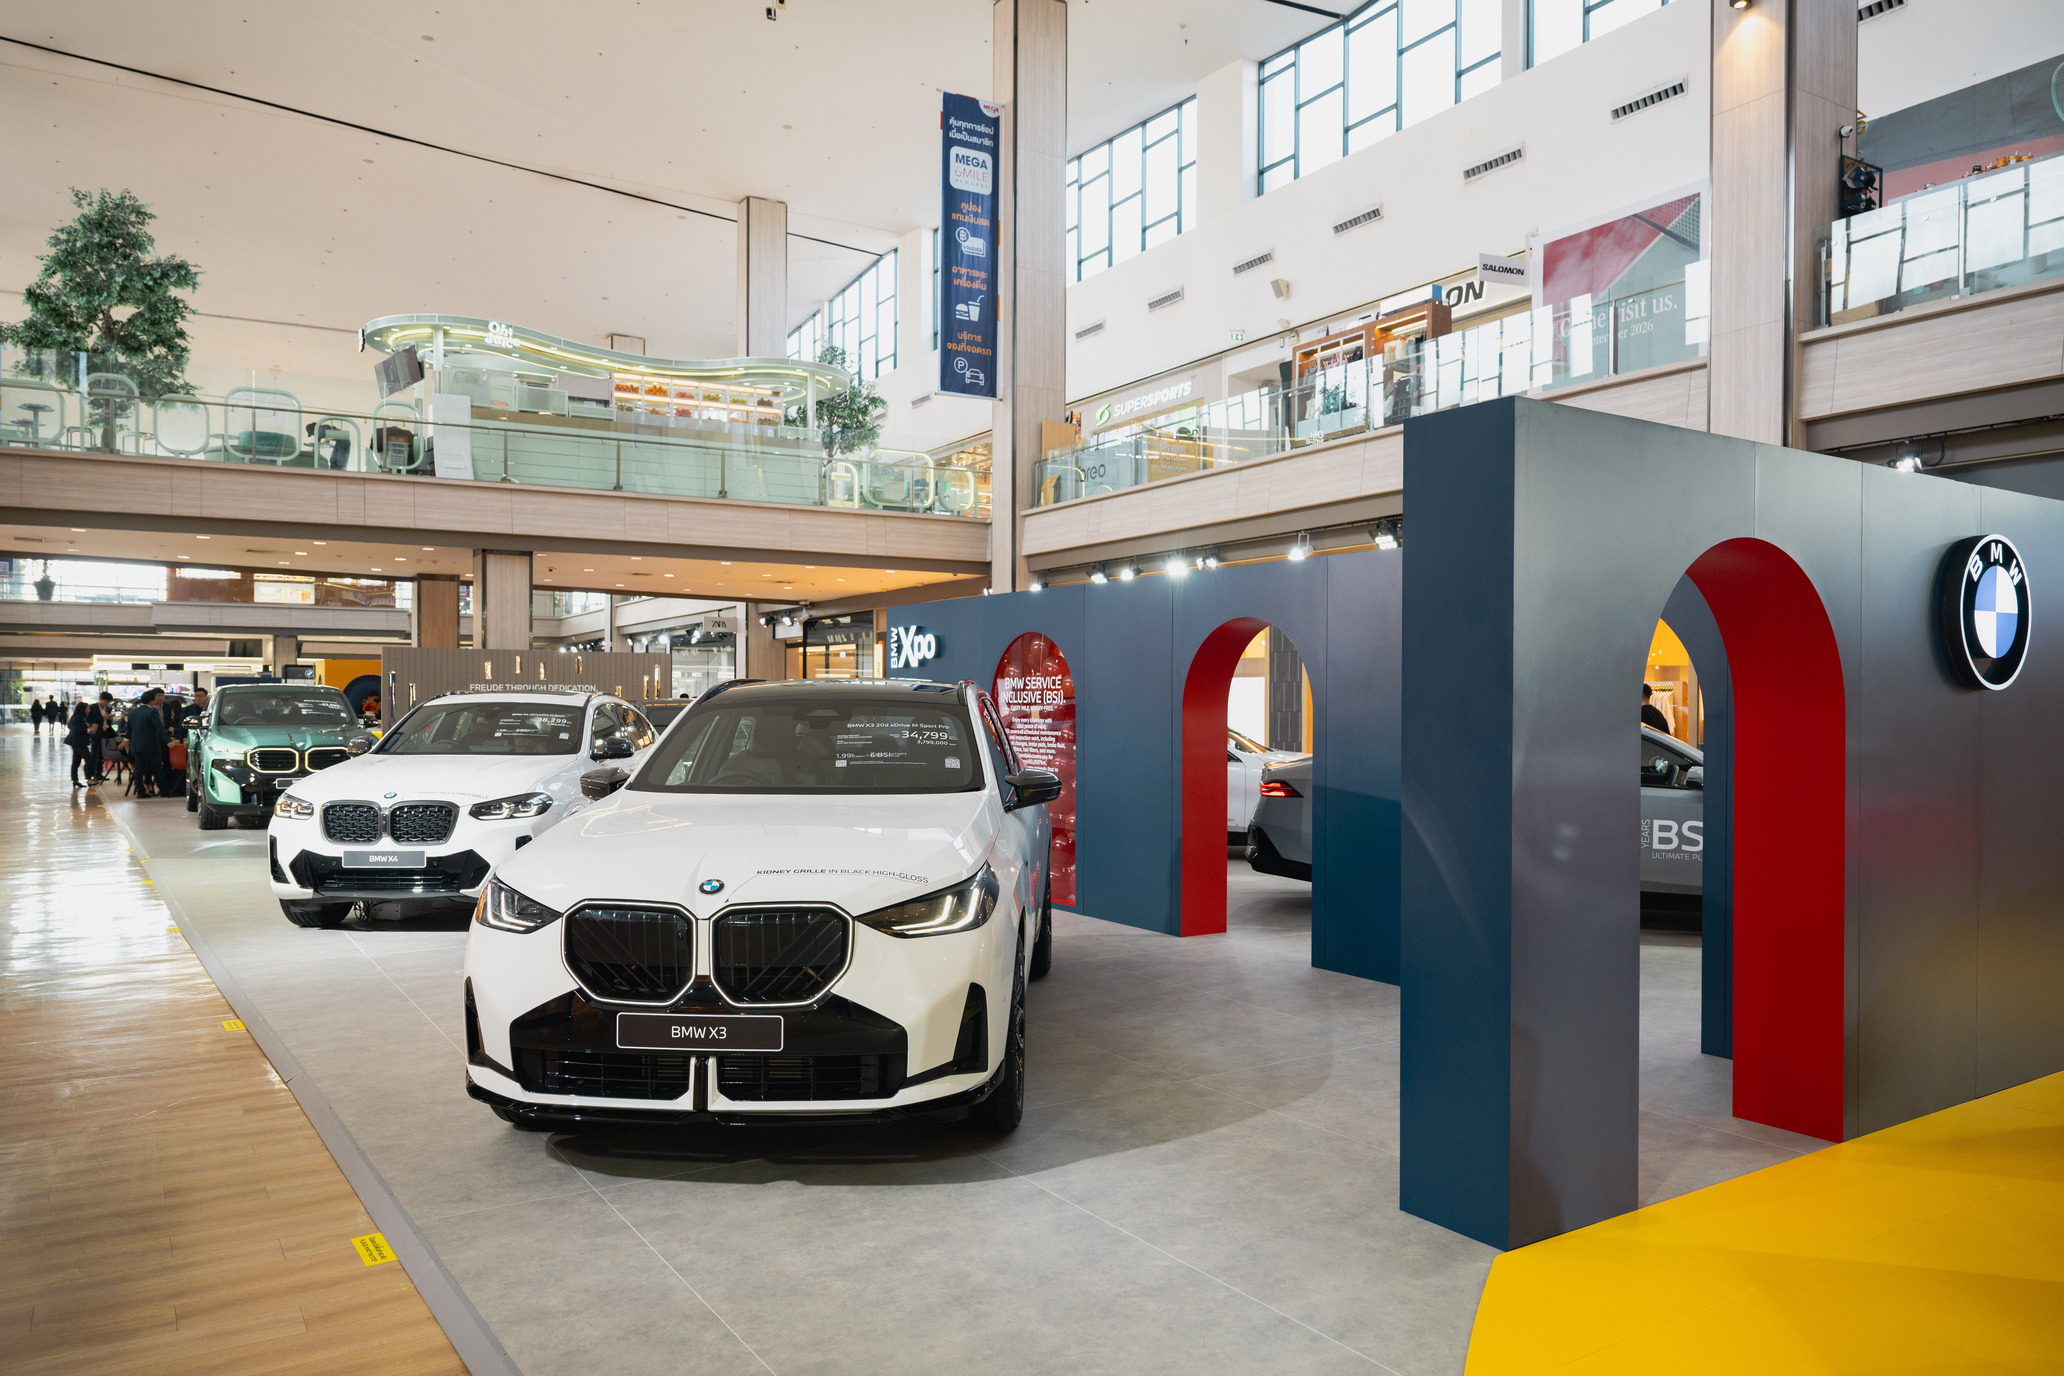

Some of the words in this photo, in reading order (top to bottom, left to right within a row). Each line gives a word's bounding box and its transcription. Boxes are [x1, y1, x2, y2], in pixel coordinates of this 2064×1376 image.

[956, 153, 987, 169] MEGA
[955, 166, 988, 182] SMILE
[961, 202, 981, 213] คูปอง
[952, 213, 990, 226] แทนเงินสด
[952, 266, 988, 278] อาหารและ
[1482, 263, 1524, 276] SALOMON
[954, 276, 986, 290] เครื่องดื่ม
[1652, 294, 1678, 314] us.
[488, 320, 513, 337] Oh!
[1630, 319, 1653, 337] 2026
[485, 332, 520, 348] Juice
[958, 331, 982, 342] บริการ
[947, 341, 992, 356] จองที่จอดรถ
[1113, 381, 1192, 417] SUPERSPORTS
[1079, 464, 1106, 482] breo
[1969, 542, 2022, 586] BMW
[712, 620, 727, 628] ZARA
[890, 627, 898, 668] BMW
[898, 625, 936, 668] Xpo
[470, 684, 504, 692] FREUDE
[548, 684, 598, 692] DEDICATION.
[1005, 677, 1024, 689] BMW
[1025, 676, 1062, 689] SERVICE
[1000, 691, 1042, 703] INCLUSIVE
[1044, 690, 1066, 704] (BSI).
[901, 731, 948, 740] 34,799
[1641, 819, 1650, 848] YEARS
[1652, 820, 1703, 852] BS
[1652, 852, 1690, 860] ULTIMATE
[872, 870, 929, 883] HIGH-GLOSS
[671, 1026, 706, 1038] BMW
[708, 1027, 727, 1039] X3
